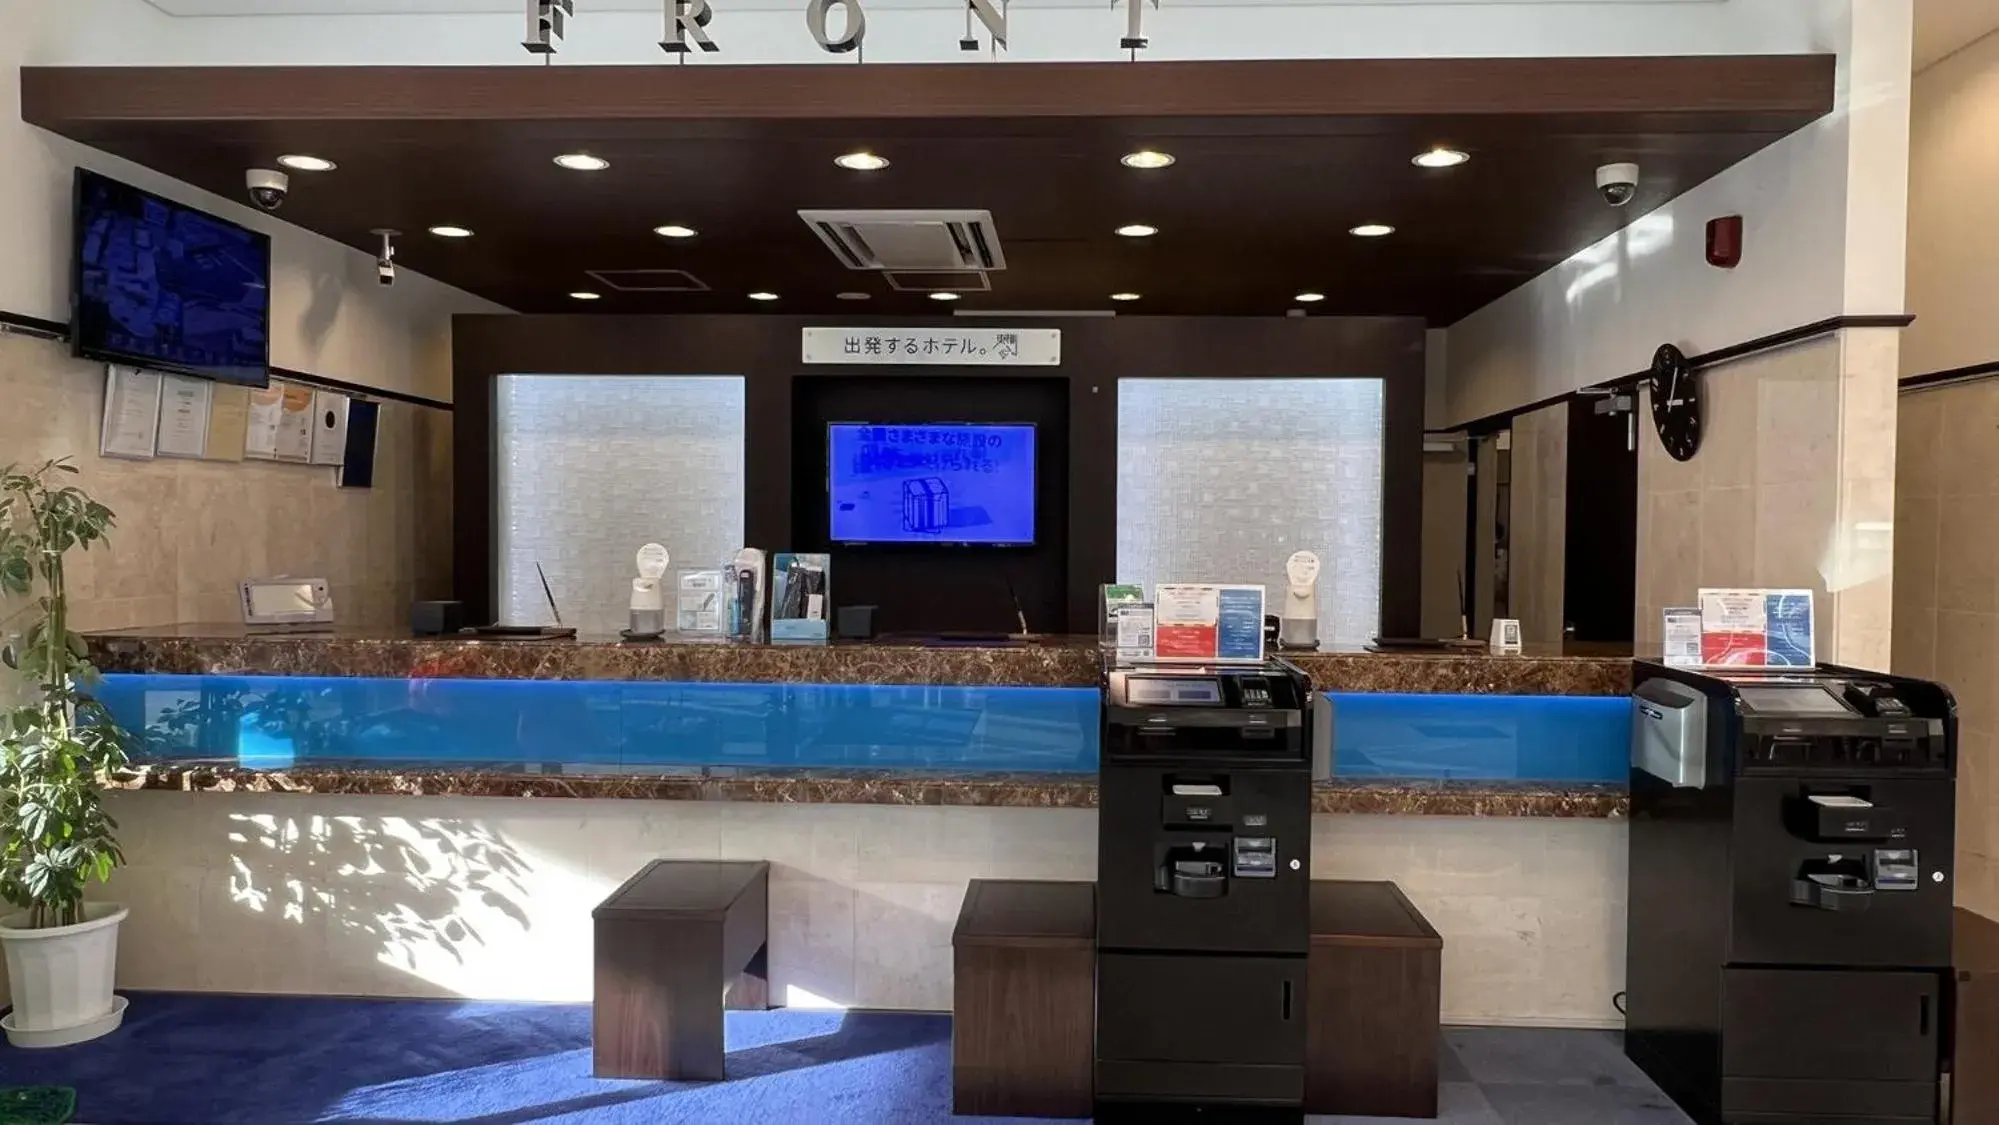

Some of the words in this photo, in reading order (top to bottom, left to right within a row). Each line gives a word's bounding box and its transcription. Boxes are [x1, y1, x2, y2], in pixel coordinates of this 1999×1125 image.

[521, 0, 1158, 53] FRONT
[844, 336, 986, 356] 出発するホテル。
